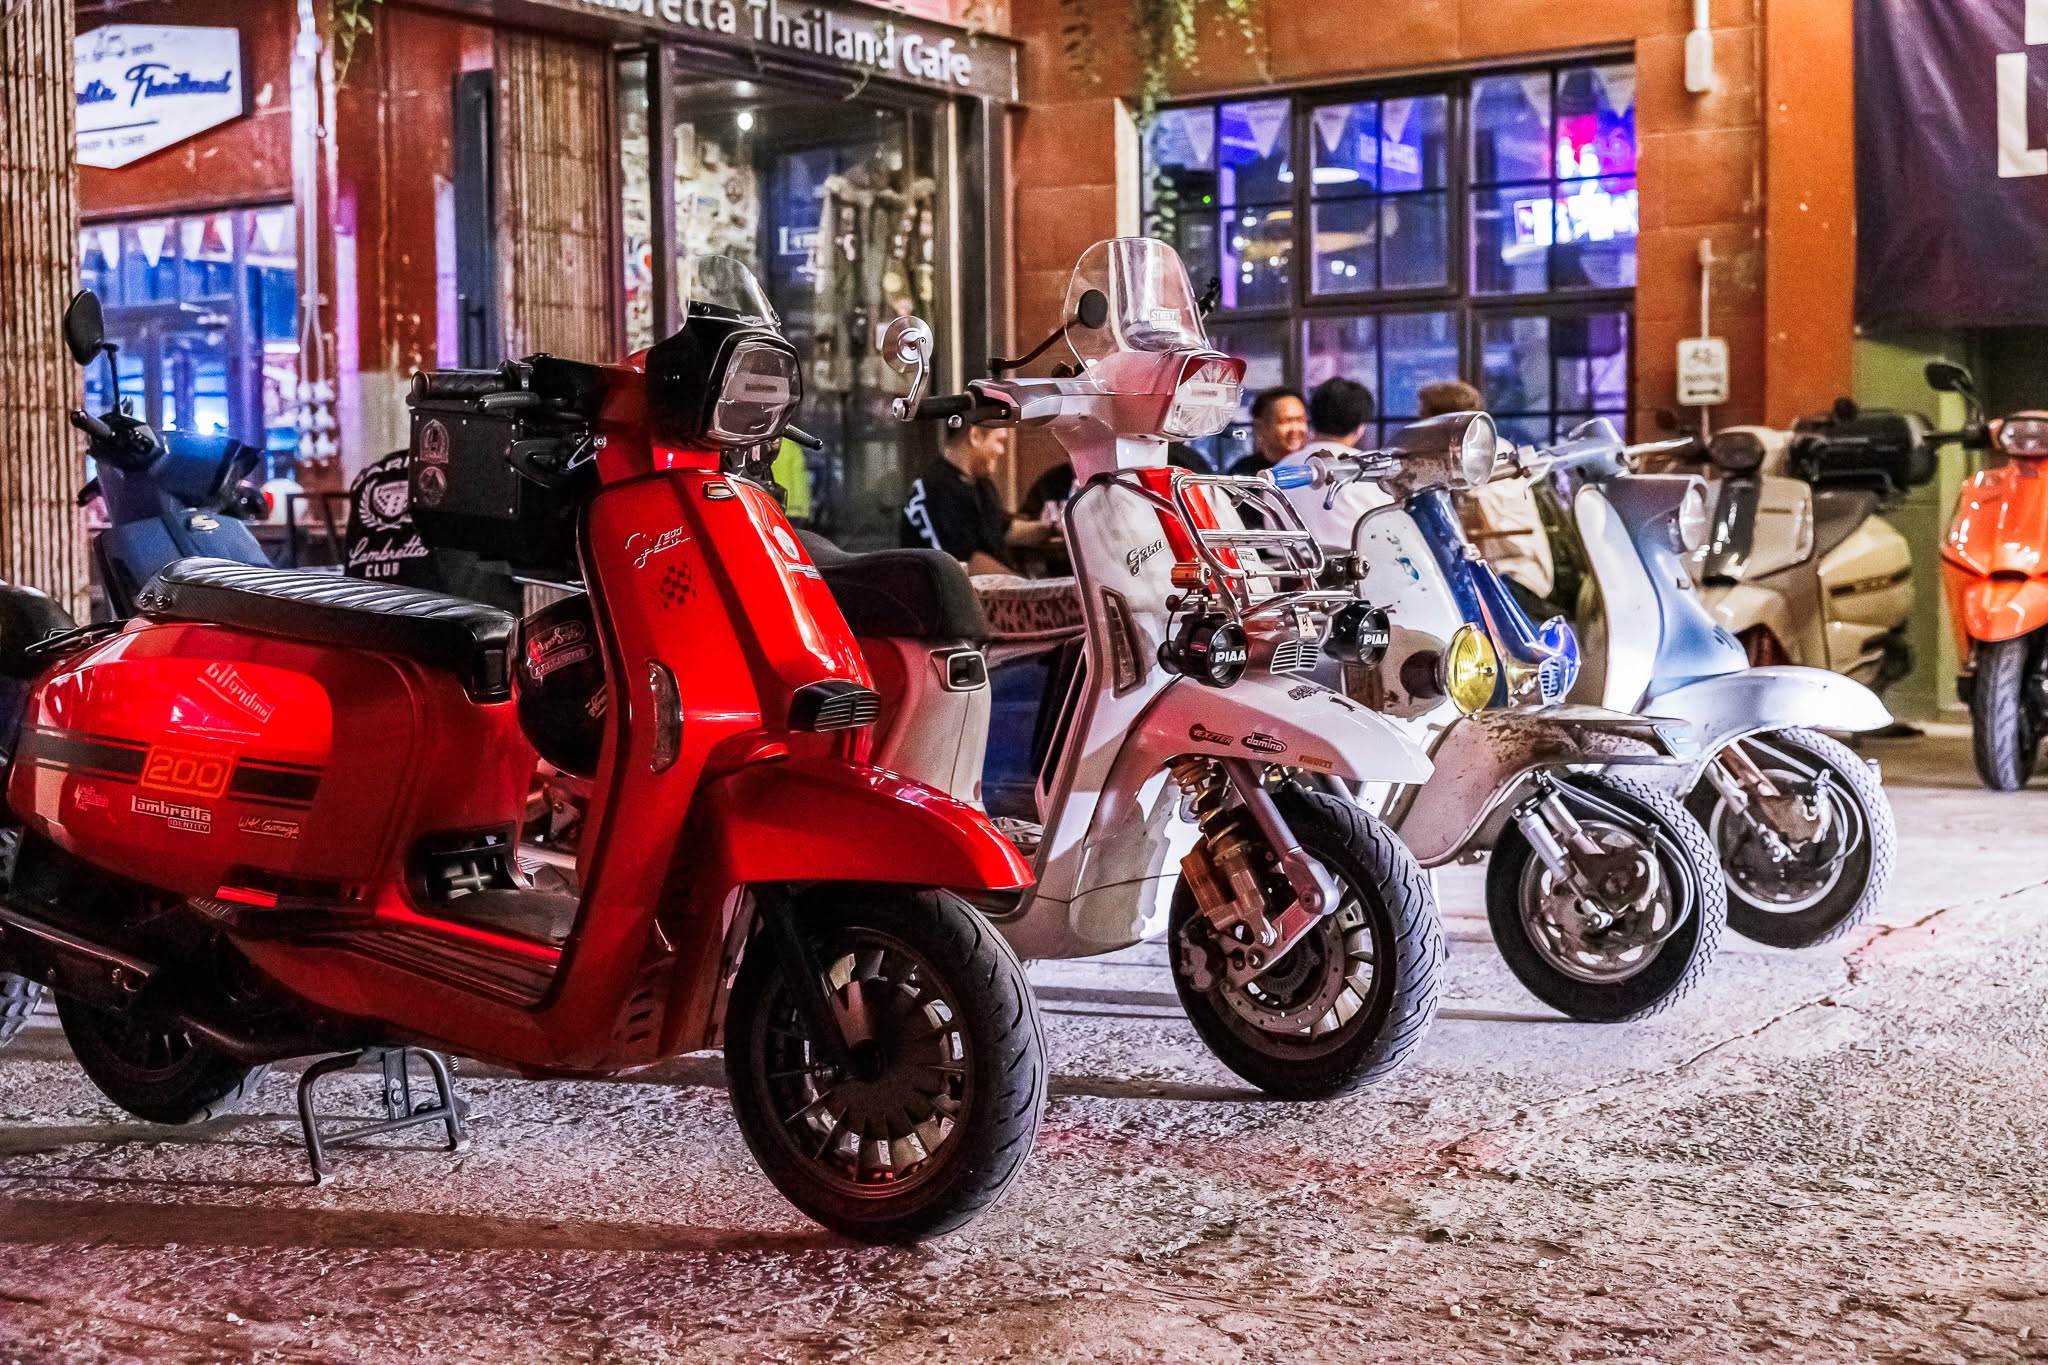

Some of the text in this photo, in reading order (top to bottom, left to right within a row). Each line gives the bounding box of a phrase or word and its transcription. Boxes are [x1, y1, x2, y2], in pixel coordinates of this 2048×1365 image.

[748, 0, 896, 70] Thailand
[902, 34, 972, 86] Cafe
[348, 535, 430, 568] Lambretta
[365, 561, 400, 577] CLUB
[1363, 633, 1389, 645] PIAA
[1215, 650, 1247, 663] PIAA
[147, 754, 225, 789] 200
[131, 794, 212, 822] Lambretta
[170, 819, 208, 831] IDENTITY
